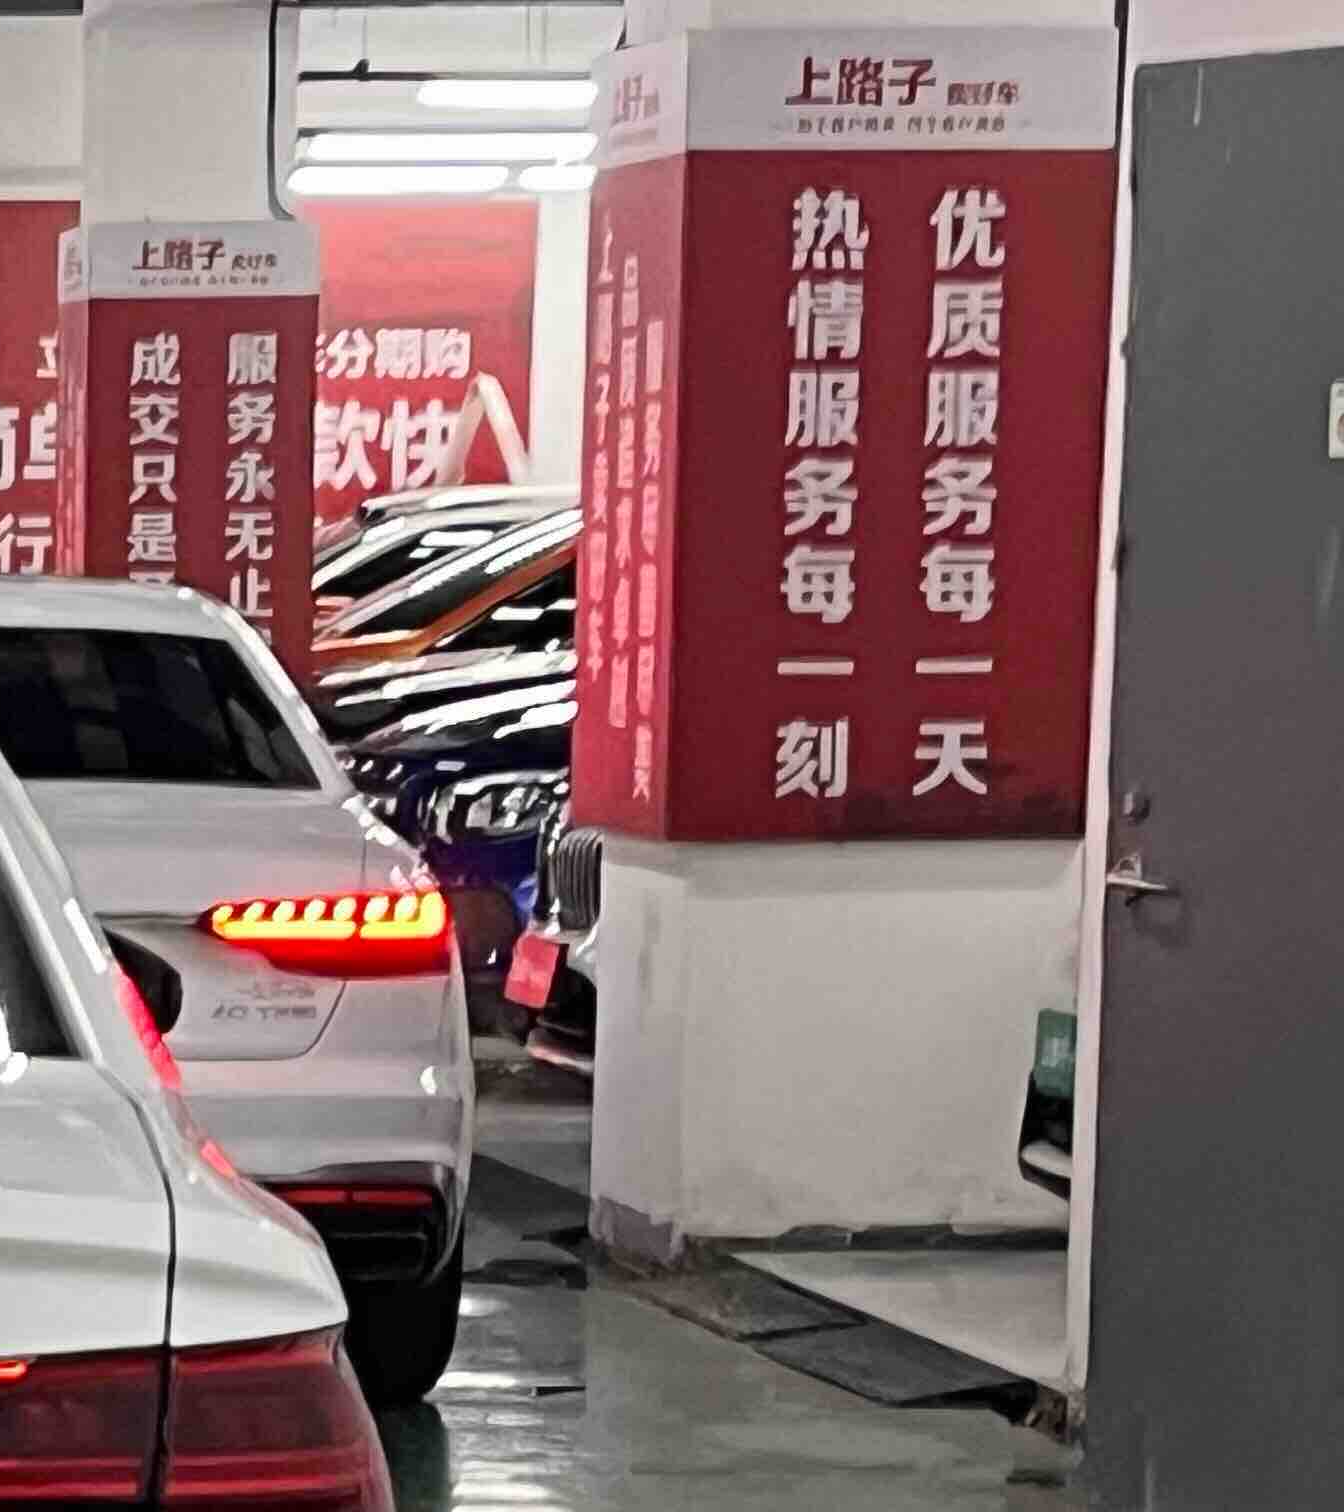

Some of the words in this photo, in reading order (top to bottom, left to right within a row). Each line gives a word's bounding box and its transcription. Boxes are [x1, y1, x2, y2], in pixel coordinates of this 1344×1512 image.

[784, 55, 937, 106] 上路子
[132, 240, 226, 271] 上路子
[315, 328, 471, 379] 分期购
[126, 332, 181, 586] 成交只是
[224, 333, 278, 646] 服务永无止
[775, 187, 870, 800] 热情服务每一刻
[912, 185, 1006, 796] 优质服务每一天
